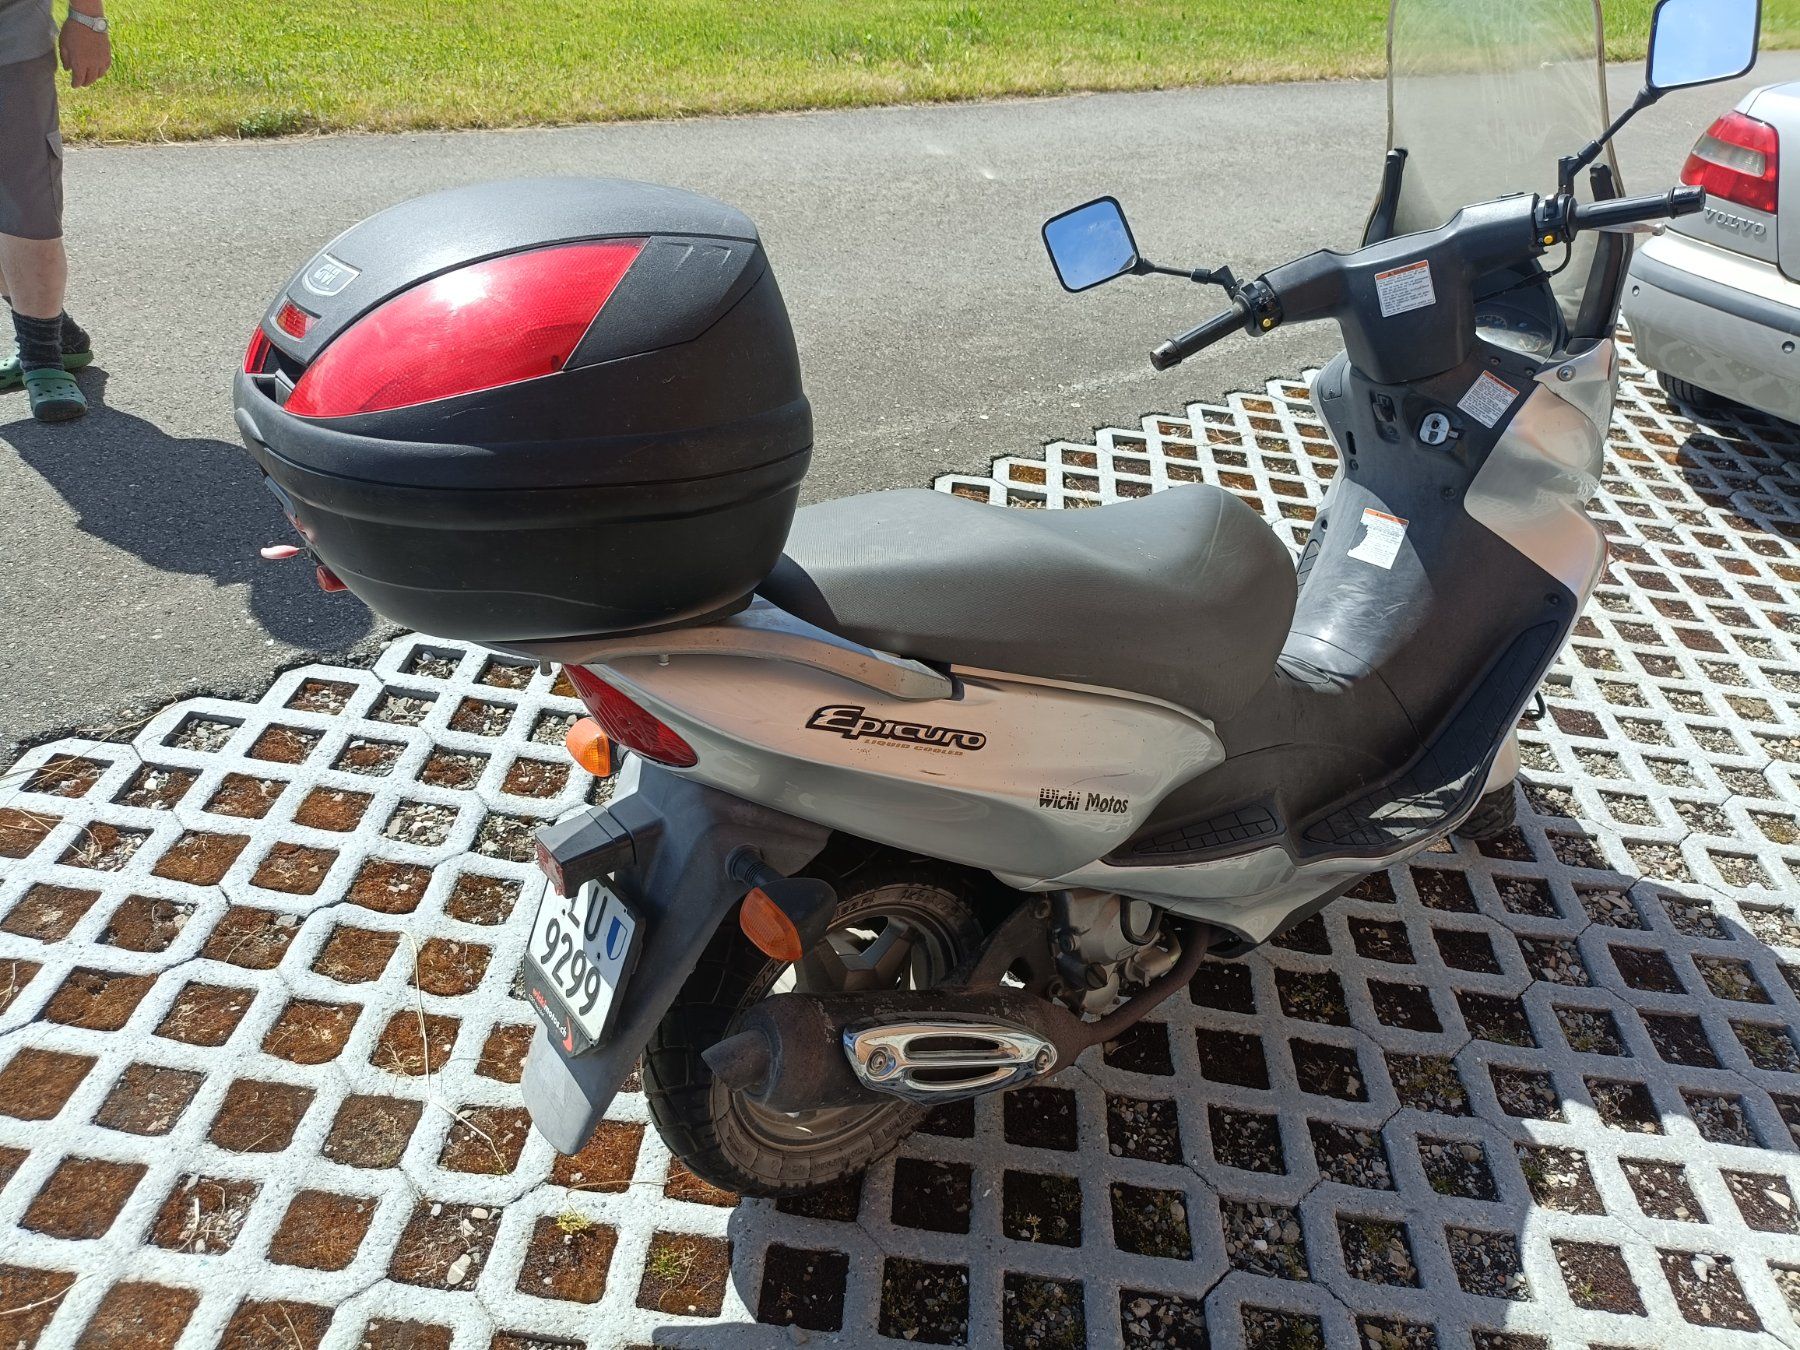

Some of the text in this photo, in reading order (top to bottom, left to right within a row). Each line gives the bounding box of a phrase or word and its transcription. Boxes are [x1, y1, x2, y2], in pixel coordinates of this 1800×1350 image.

[1704, 206, 1766, 236] VOLVO
[805, 704, 987, 751] Epicuro
[864, 738, 964, 757] LIQUID COOLED
[1039, 787, 1128, 814] Wicki Motos
[540, 917, 601, 1017] 9299
